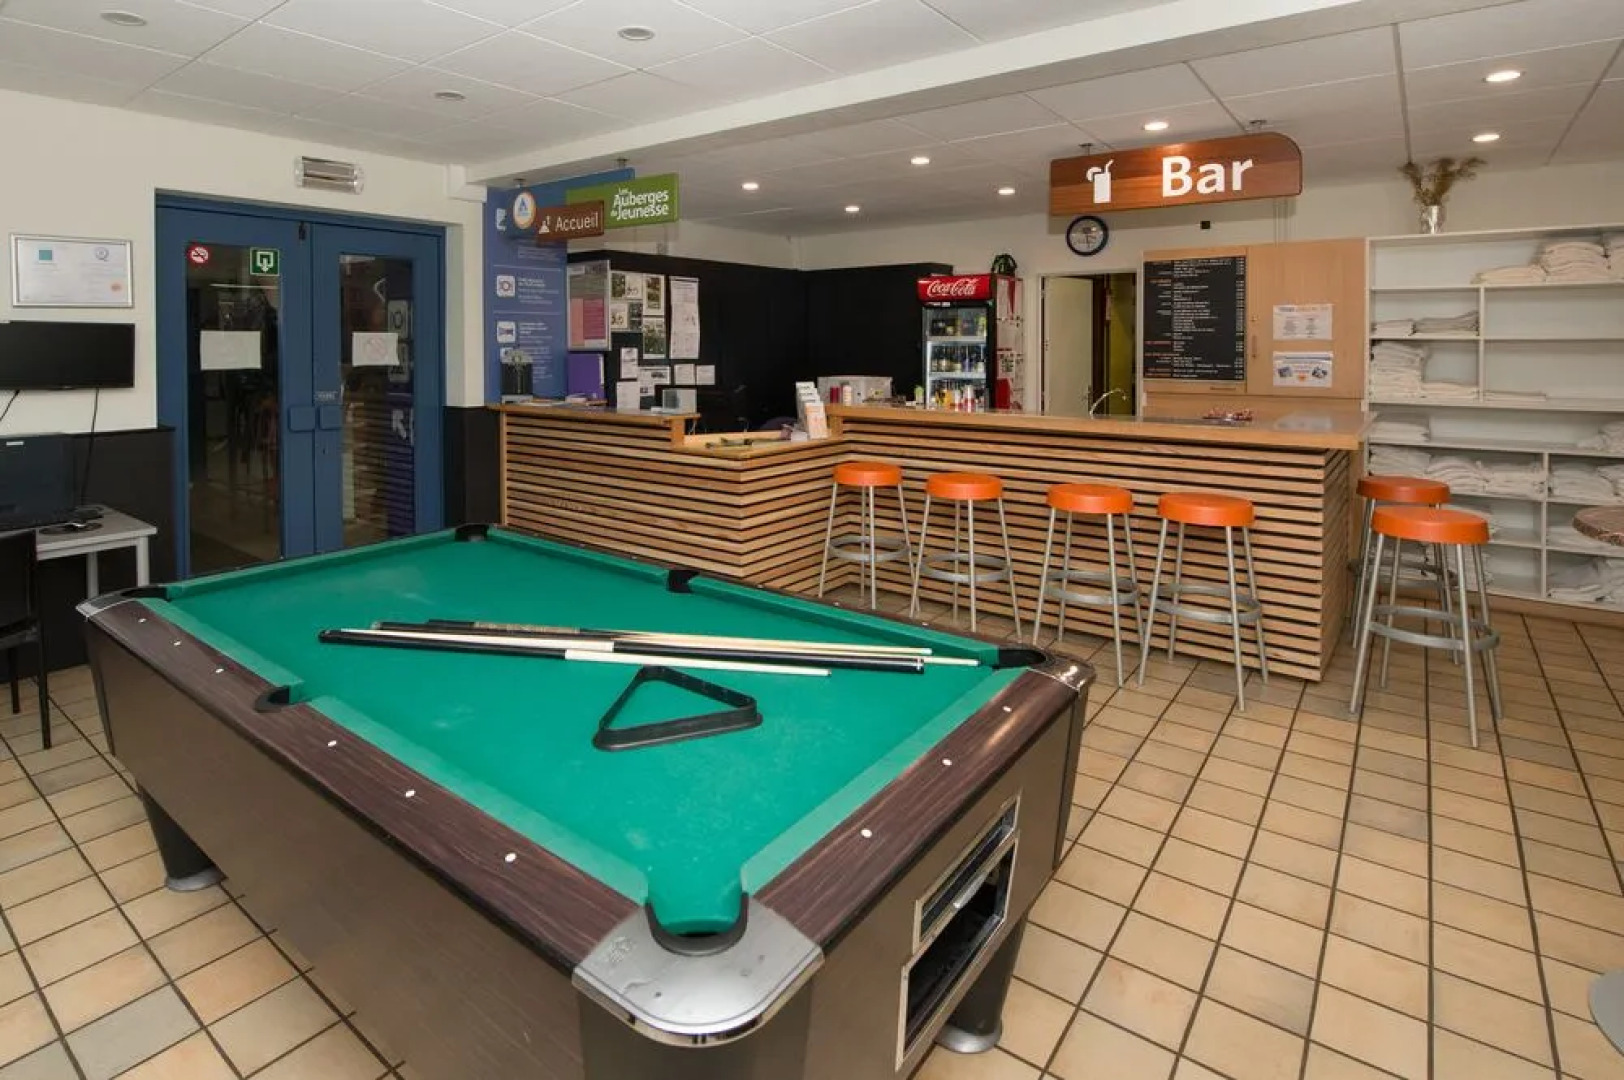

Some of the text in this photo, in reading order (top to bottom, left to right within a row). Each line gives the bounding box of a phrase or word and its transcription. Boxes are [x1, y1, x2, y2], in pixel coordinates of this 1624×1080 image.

[1162, 155, 1253, 198] Bar
[613, 190, 669, 208] Auberges
[555, 211, 599, 232] Accueil
[616, 204, 669, 221] Jeunesse
[926, 277, 980, 298] Coca-Cola
